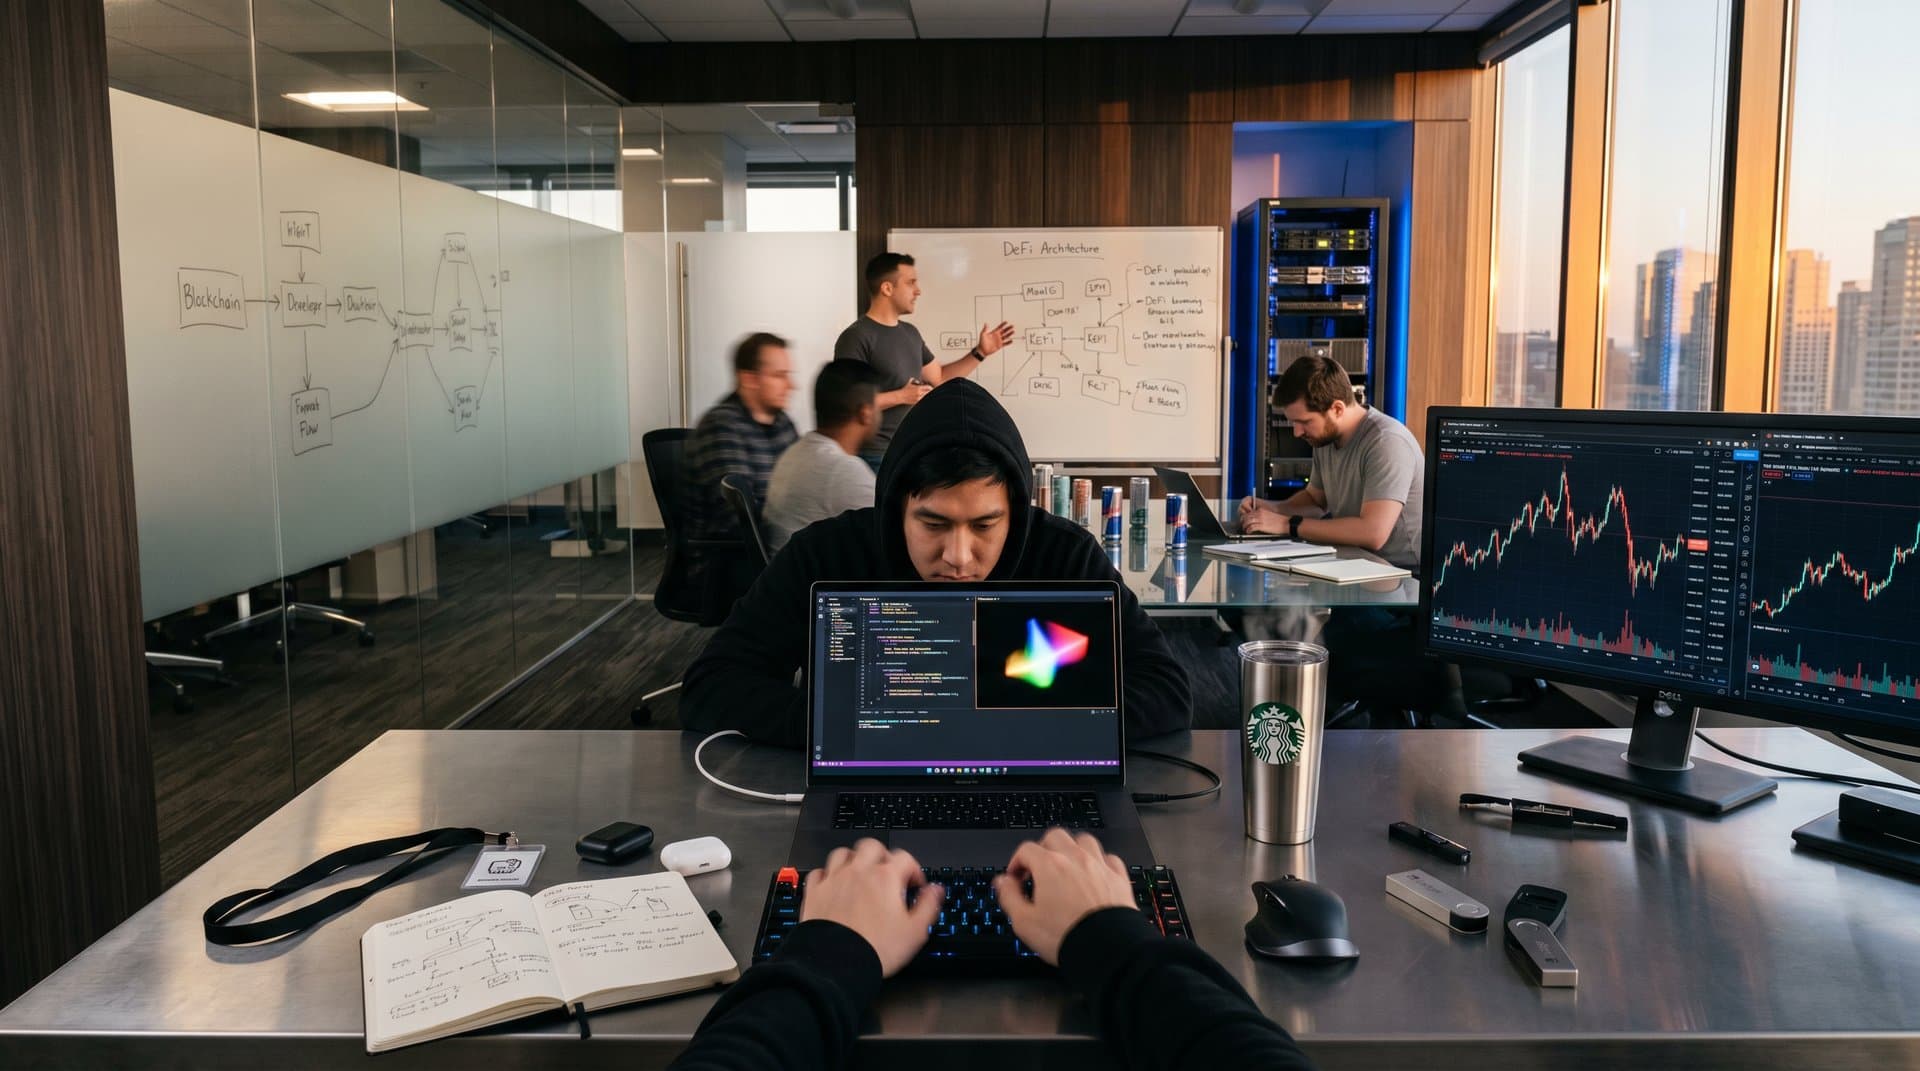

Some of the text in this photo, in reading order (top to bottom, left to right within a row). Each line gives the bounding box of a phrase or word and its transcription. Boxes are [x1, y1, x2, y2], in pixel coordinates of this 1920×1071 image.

[1003, 241, 1033, 256] DeFi
[183, 283, 241, 311] Blockchain
[1658, 690, 1683, 702] DELL
